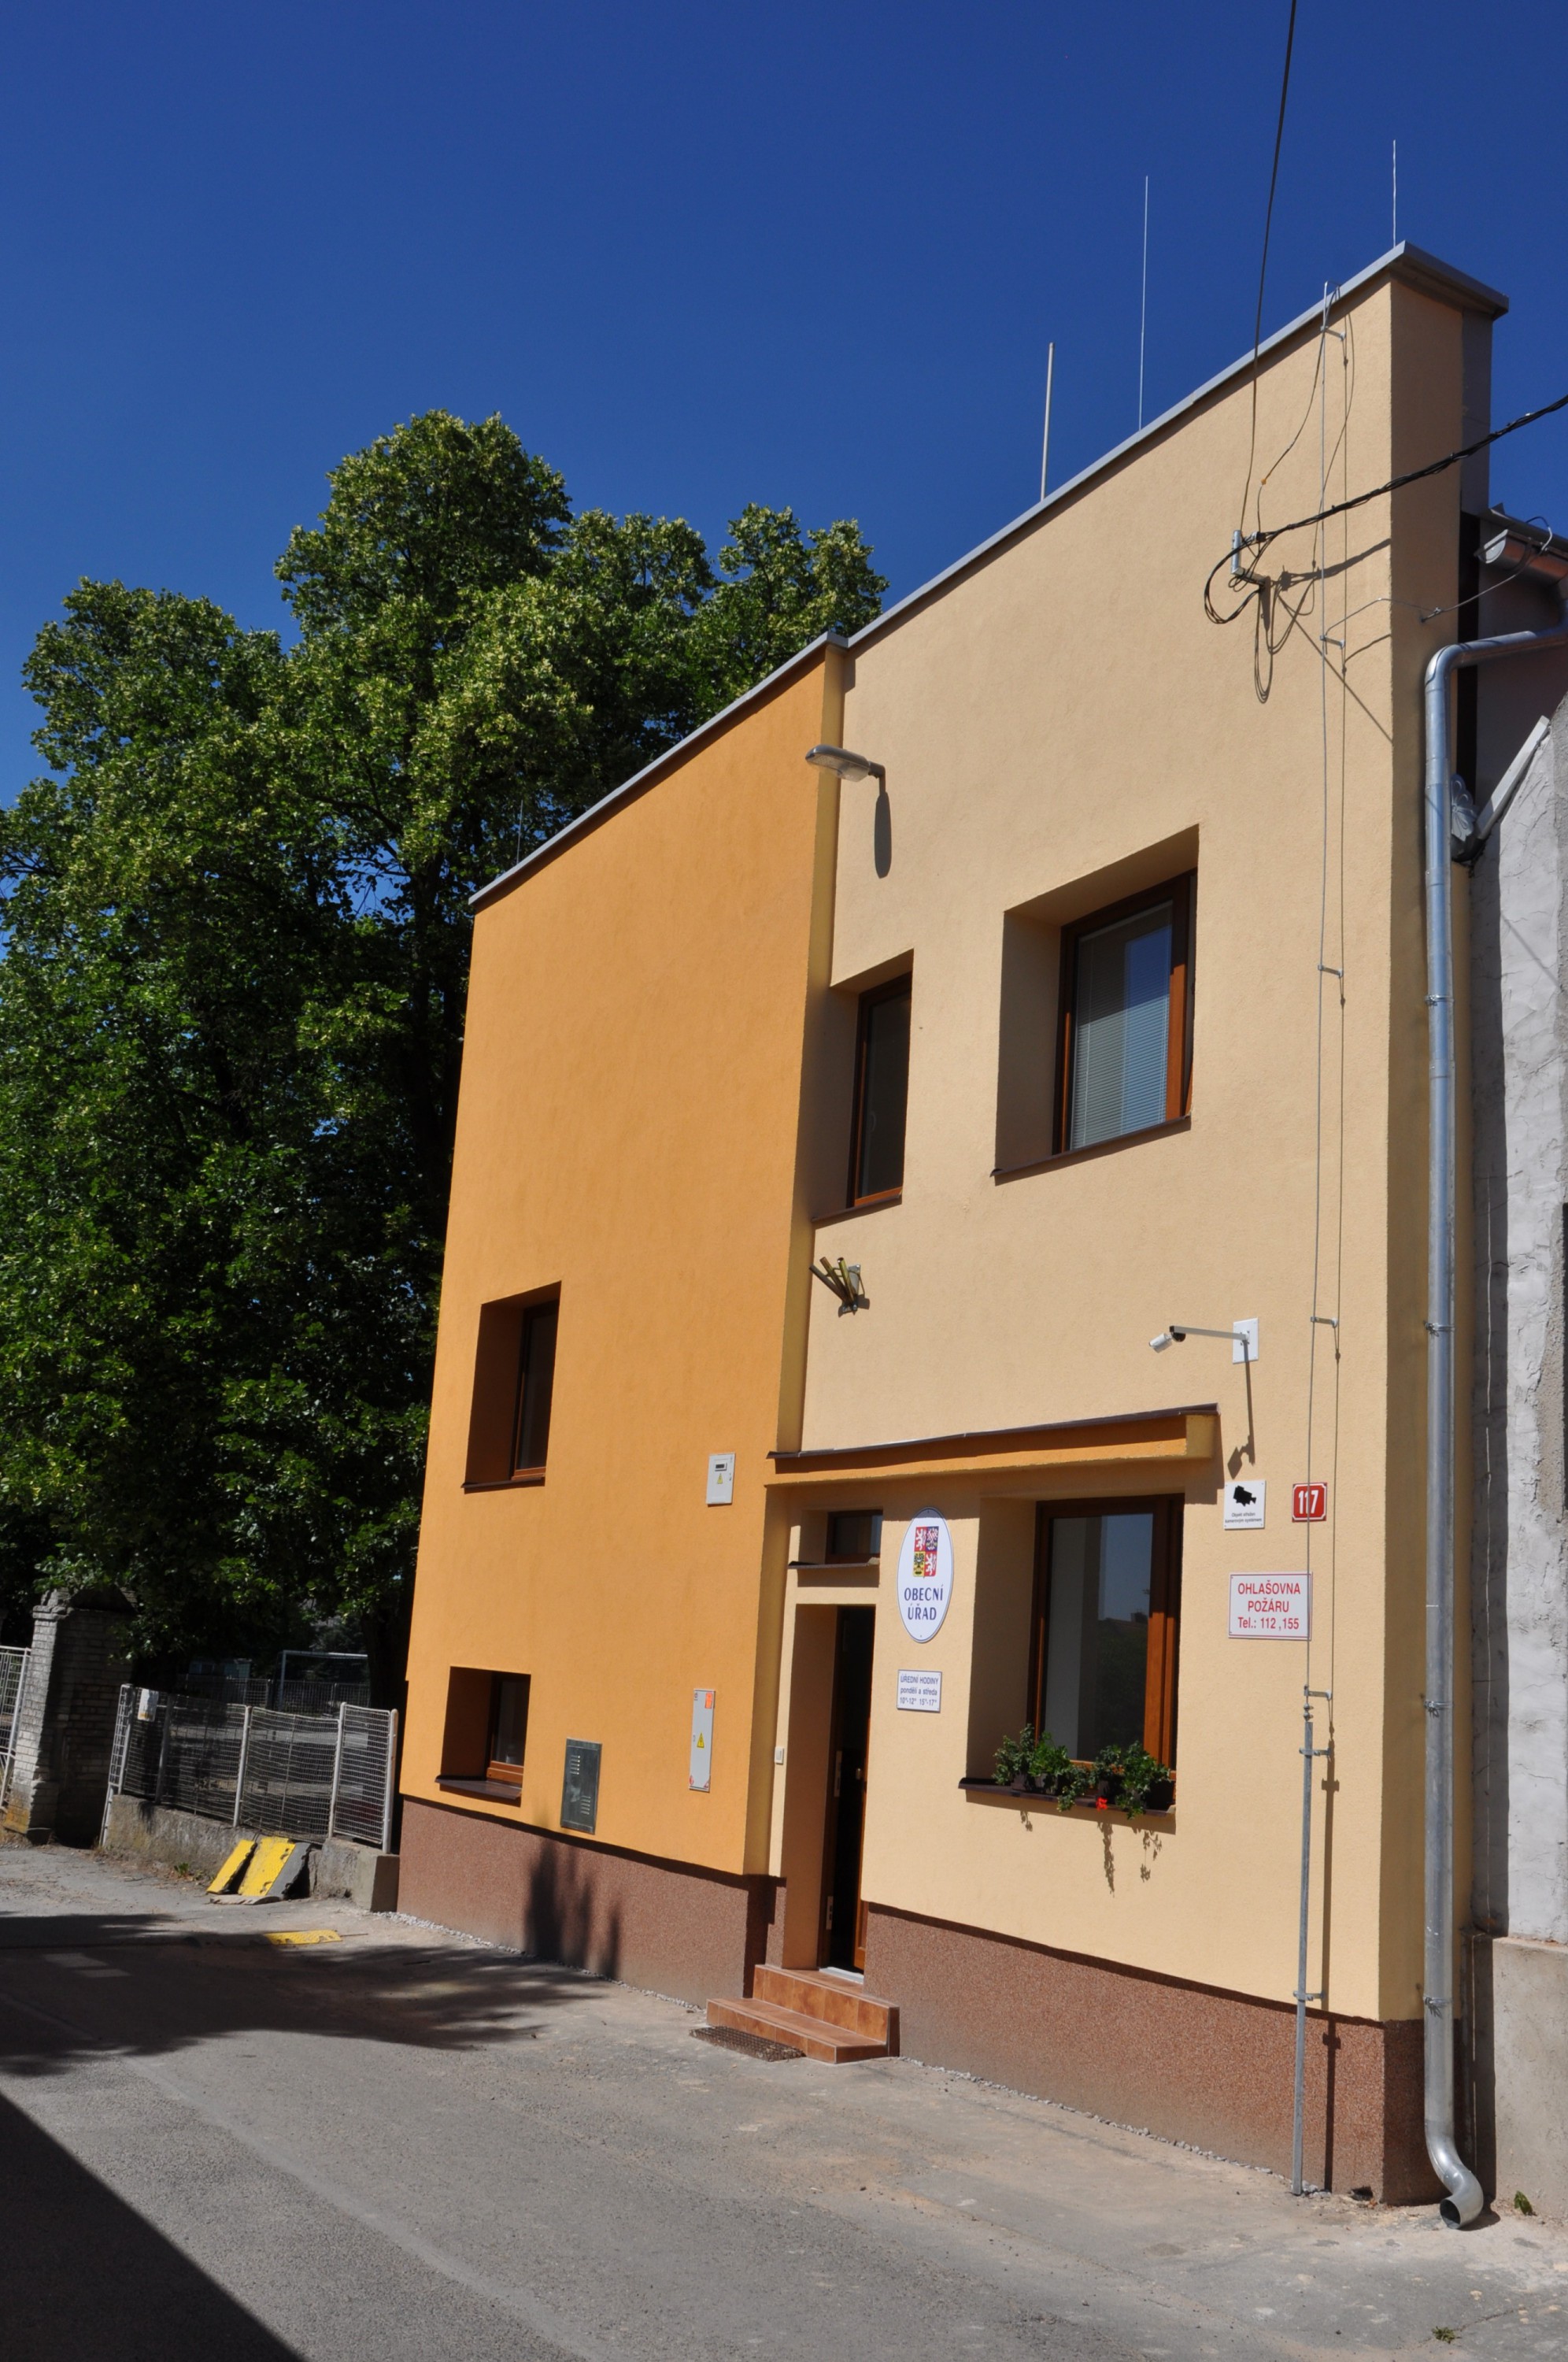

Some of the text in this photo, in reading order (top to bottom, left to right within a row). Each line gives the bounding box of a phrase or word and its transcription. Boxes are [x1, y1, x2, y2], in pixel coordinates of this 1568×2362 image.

[1299, 1490, 1319, 1514] 117
[904, 1584, 944, 1601] OBECNÍ
[1237, 1579, 1300, 1594] OHLAŠOVNA
[908, 1602, 937, 1620] ÚŘAD
[1248, 1597, 1289, 1612] POŽÁRU
[1237, 1616, 1256, 1629] Tel.:
[1260, 1617, 1276, 1629] 112
[919, 1676, 938, 1685] HODINY
